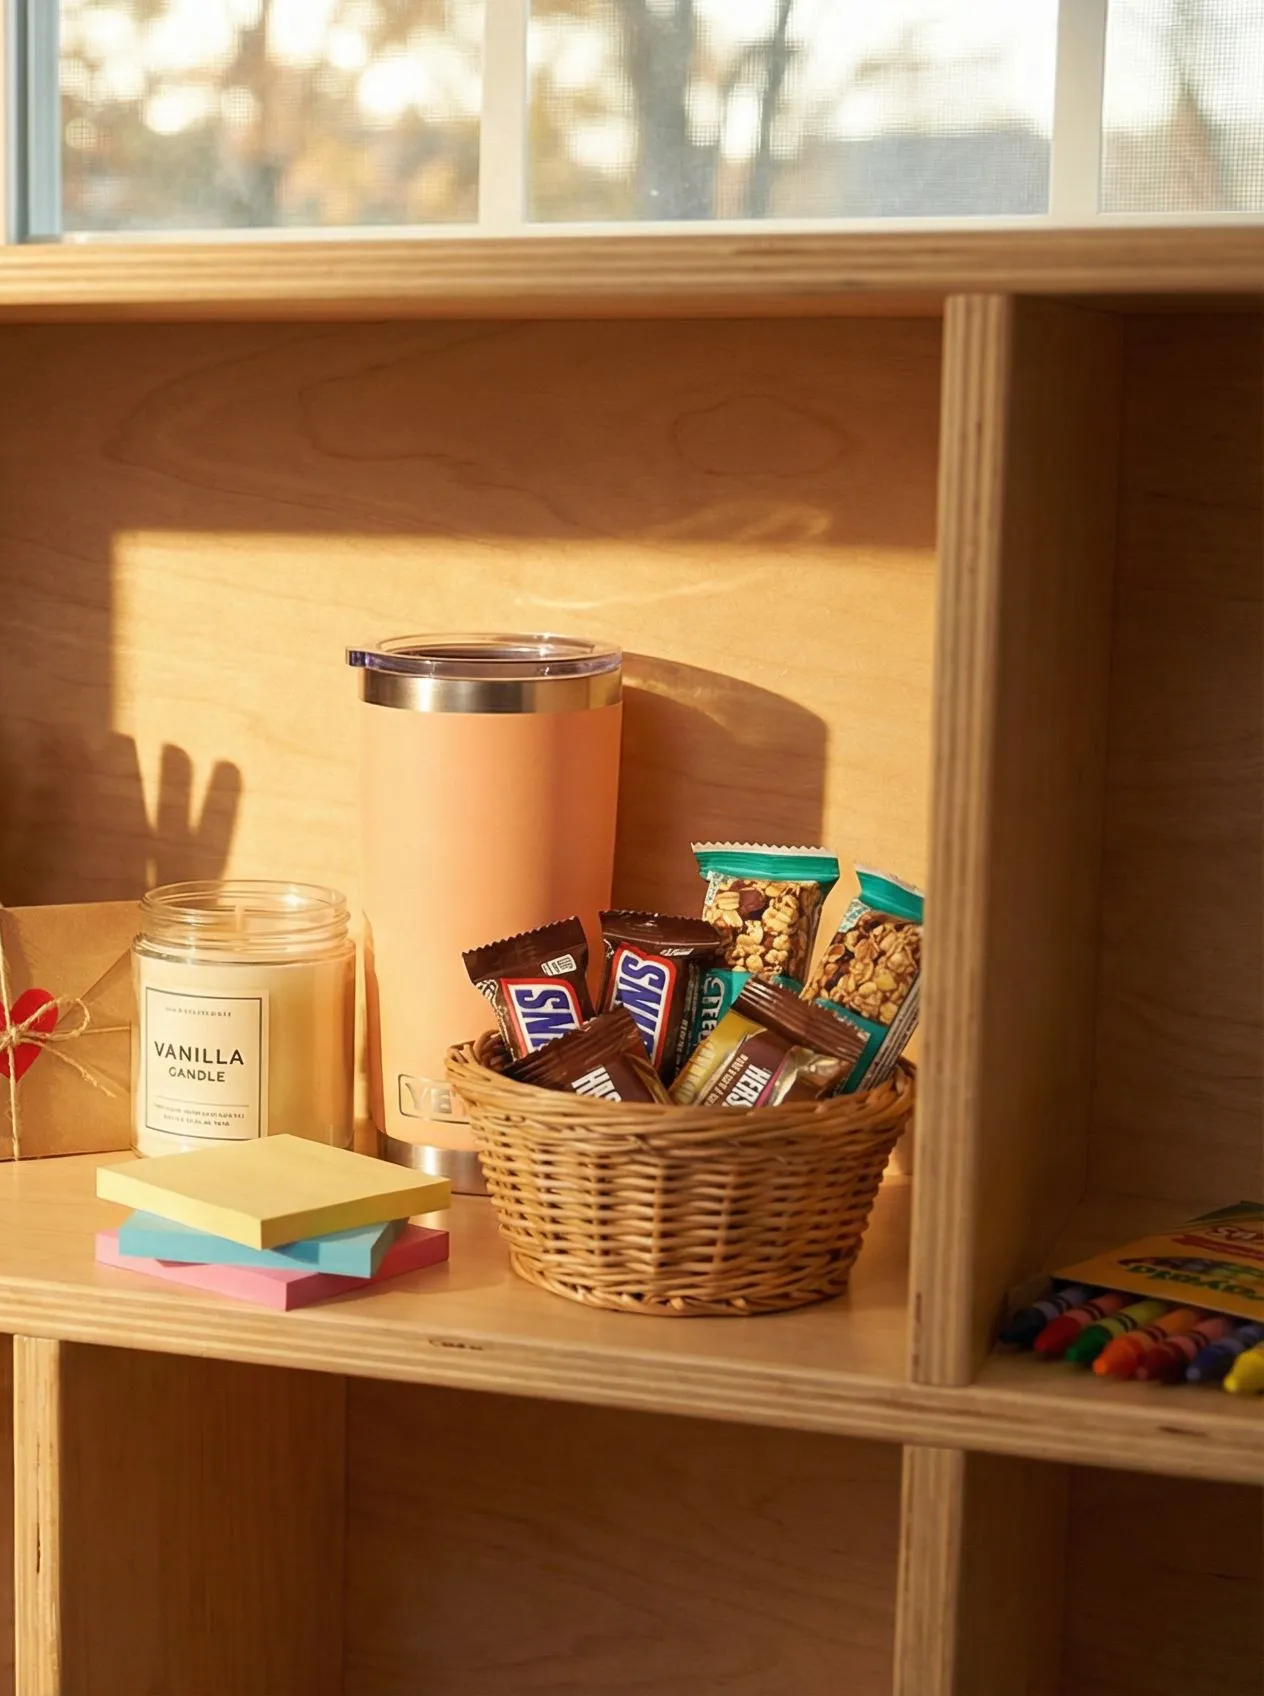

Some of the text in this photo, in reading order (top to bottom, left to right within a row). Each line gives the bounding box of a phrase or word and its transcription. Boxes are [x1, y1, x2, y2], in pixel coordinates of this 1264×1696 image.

[153, 1040, 245, 1066] VANILLA
[168, 1066, 226, 1083] CANDLE
[404, 1082, 454, 1115] YE
